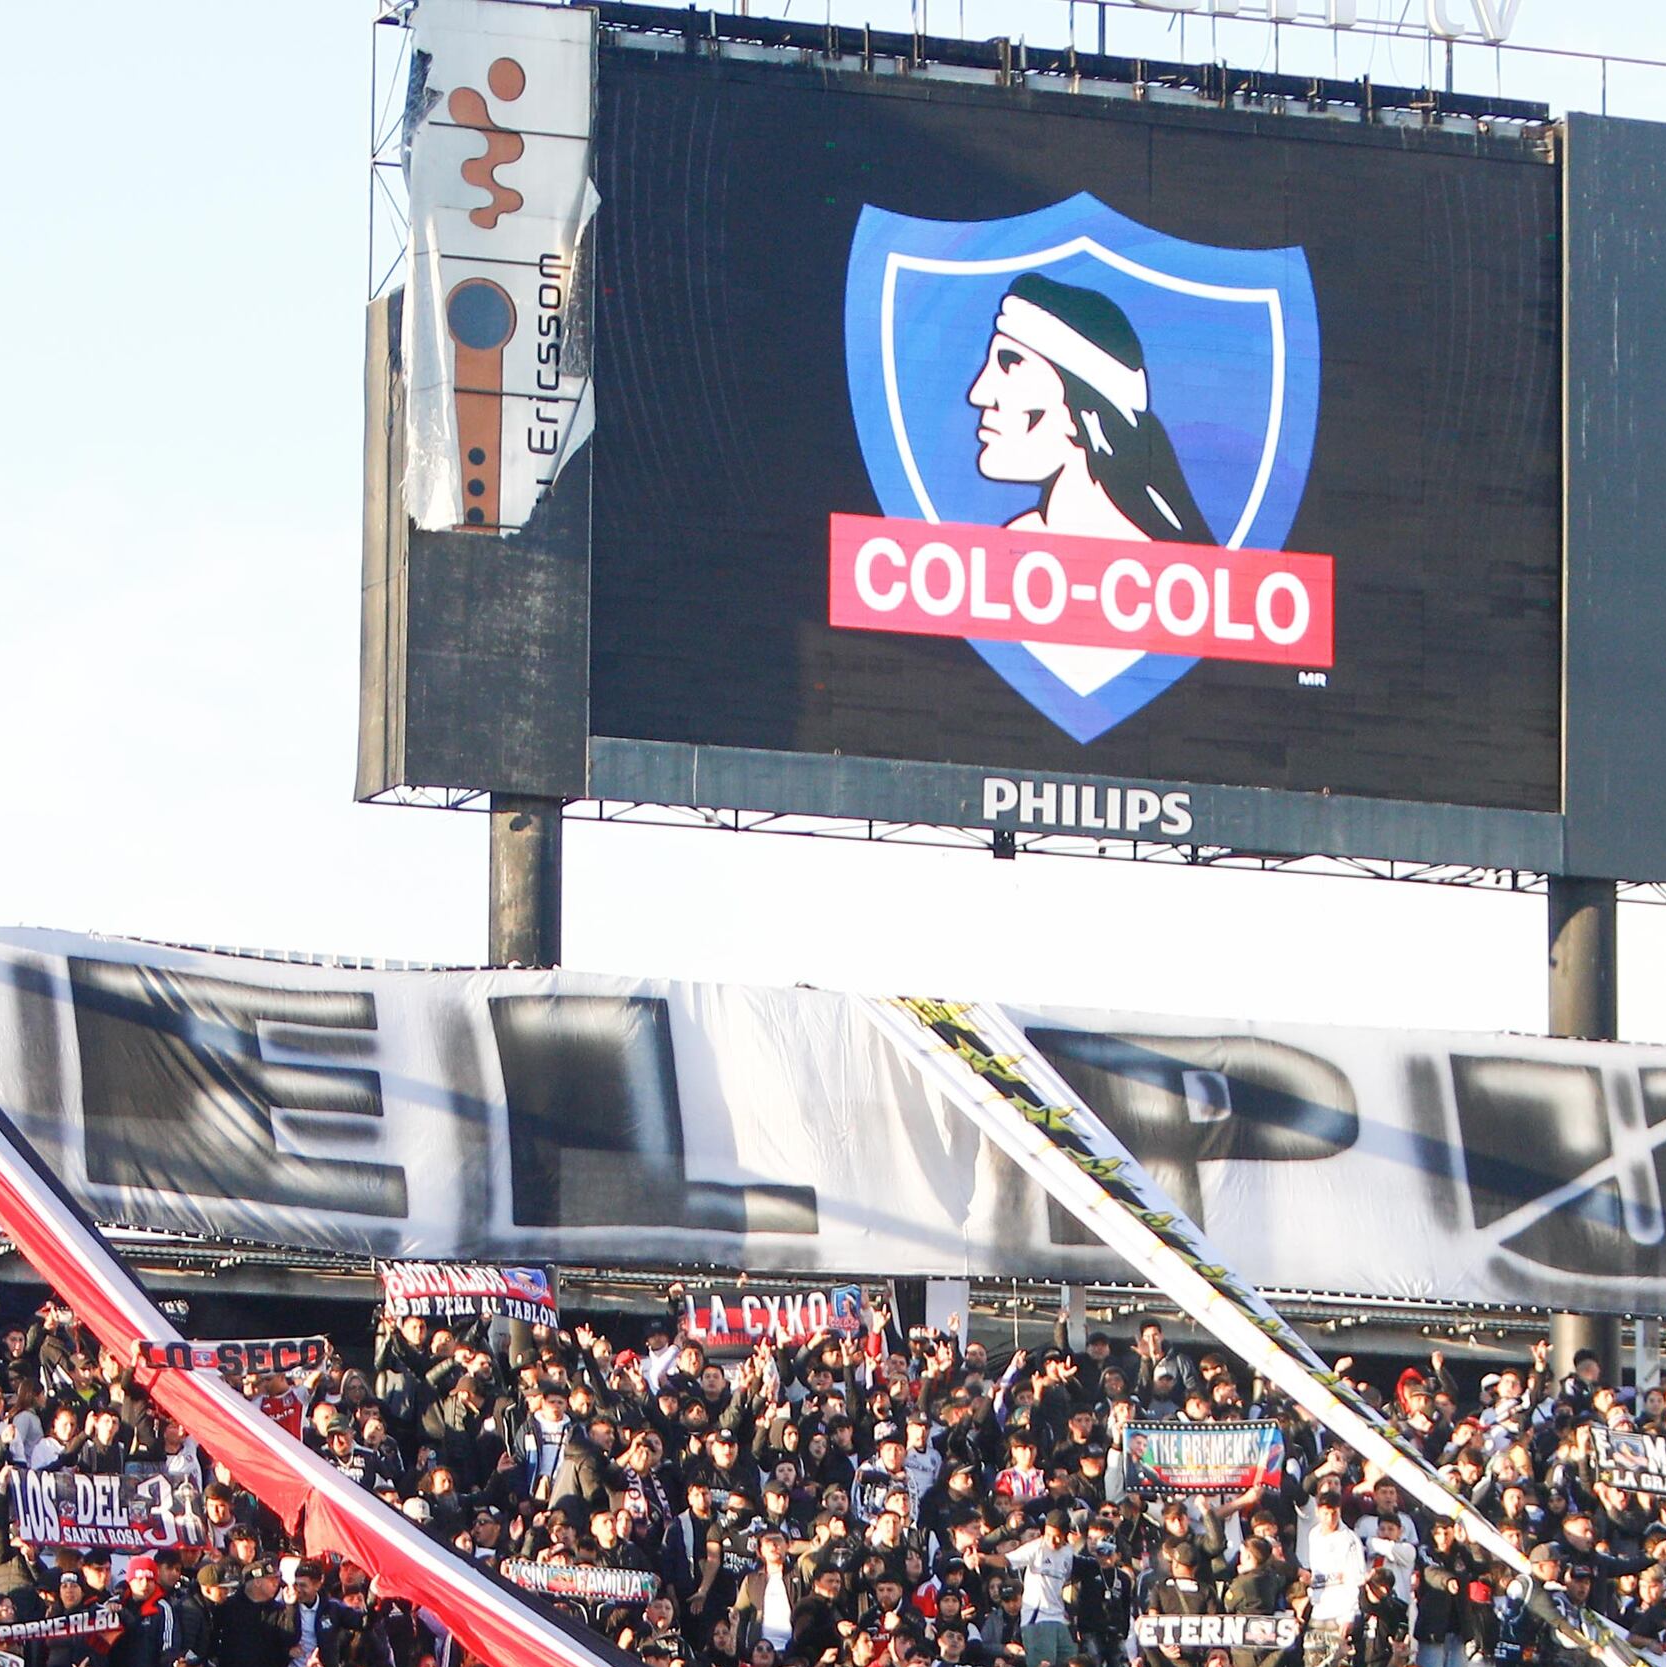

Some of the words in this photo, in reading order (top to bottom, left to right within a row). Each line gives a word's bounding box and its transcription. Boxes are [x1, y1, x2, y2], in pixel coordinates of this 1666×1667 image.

[526, 252, 561, 456] Ericsson
[852, 537, 1312, 648] COLO-COLO
[981, 775, 1194, 837] PHILIPS
[686, 1293, 730, 1338] LA
[217, 1338, 326, 1374] SECO
[1612, 1469, 1638, 1488] LA
[11, 1469, 61, 1543] LOS
[74, 1474, 129, 1527] DEL
[62, 1526, 107, 1546] SANTA
[107, 1528, 145, 1547] ROSA
[576, 1570, 644, 1598] FAMILIA
[1139, 1615, 1297, 1647] ETERNS
